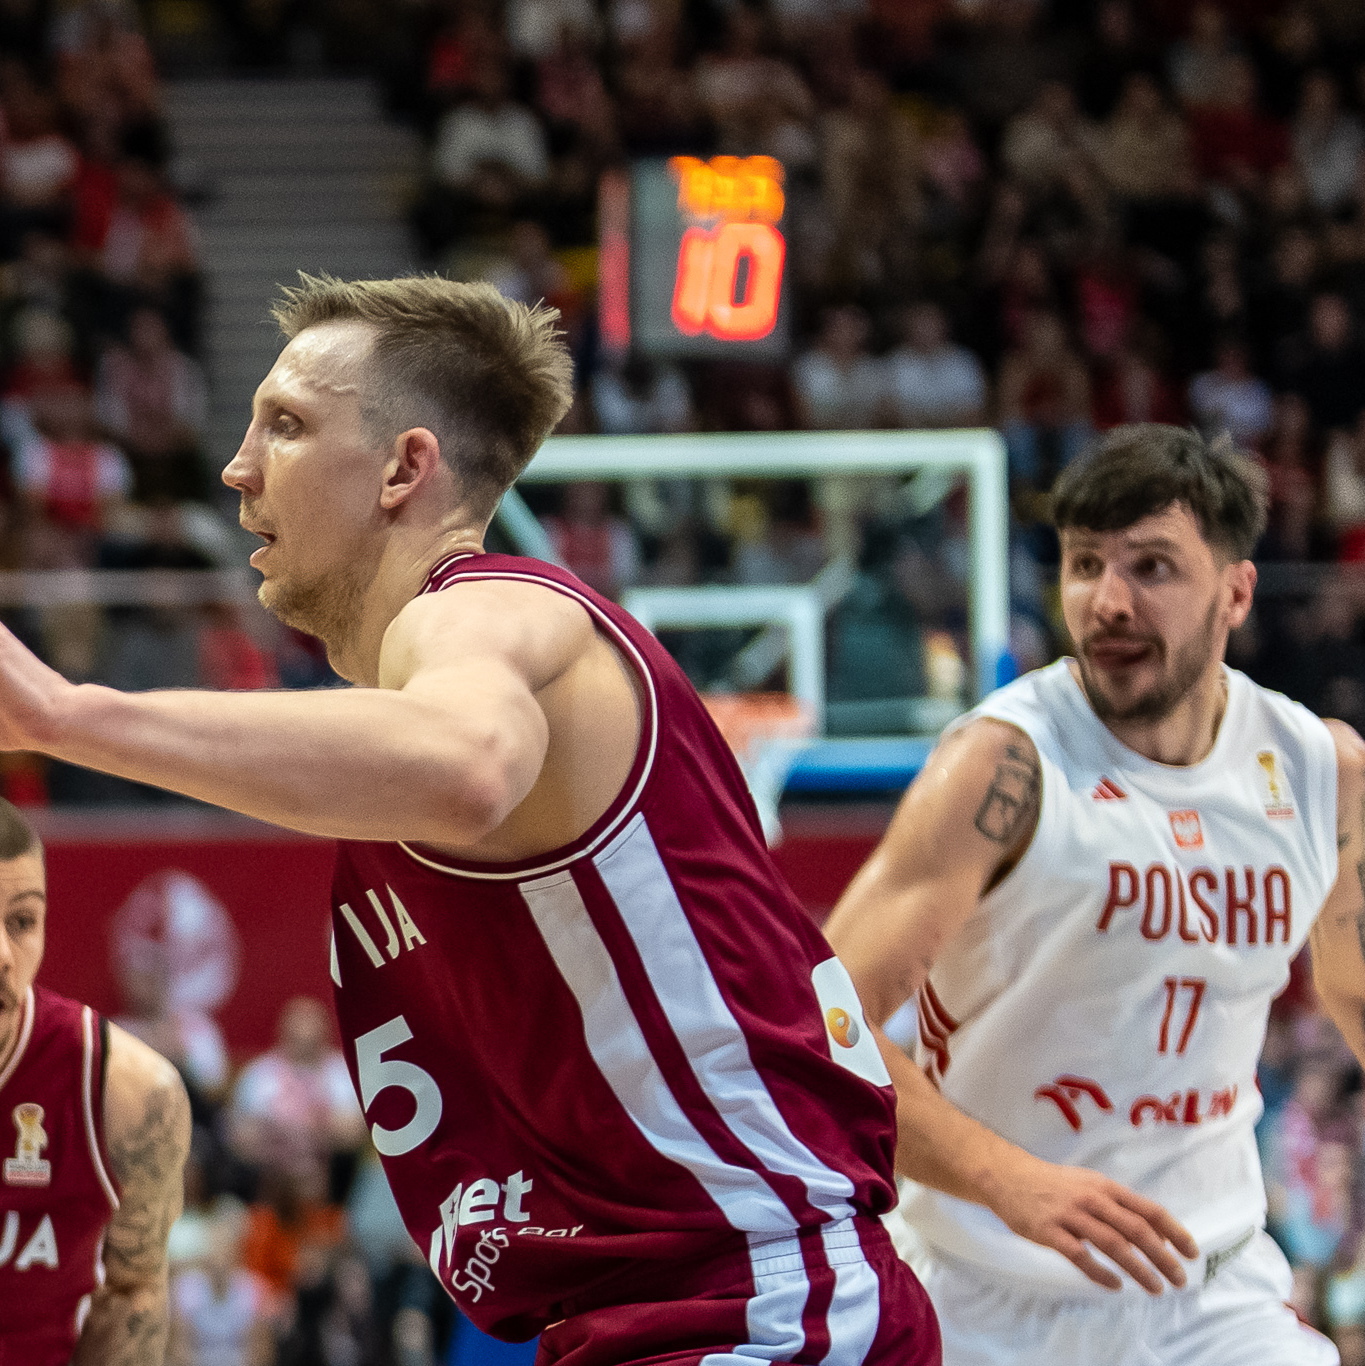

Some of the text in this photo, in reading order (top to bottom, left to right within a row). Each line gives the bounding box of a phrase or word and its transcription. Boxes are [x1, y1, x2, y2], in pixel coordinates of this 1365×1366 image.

[671, 223, 786, 341] 10
[1096, 861, 1291, 946] POLSKA
[1157, 976, 1206, 1057] 17
[355, 1014, 443, 1157] 5
